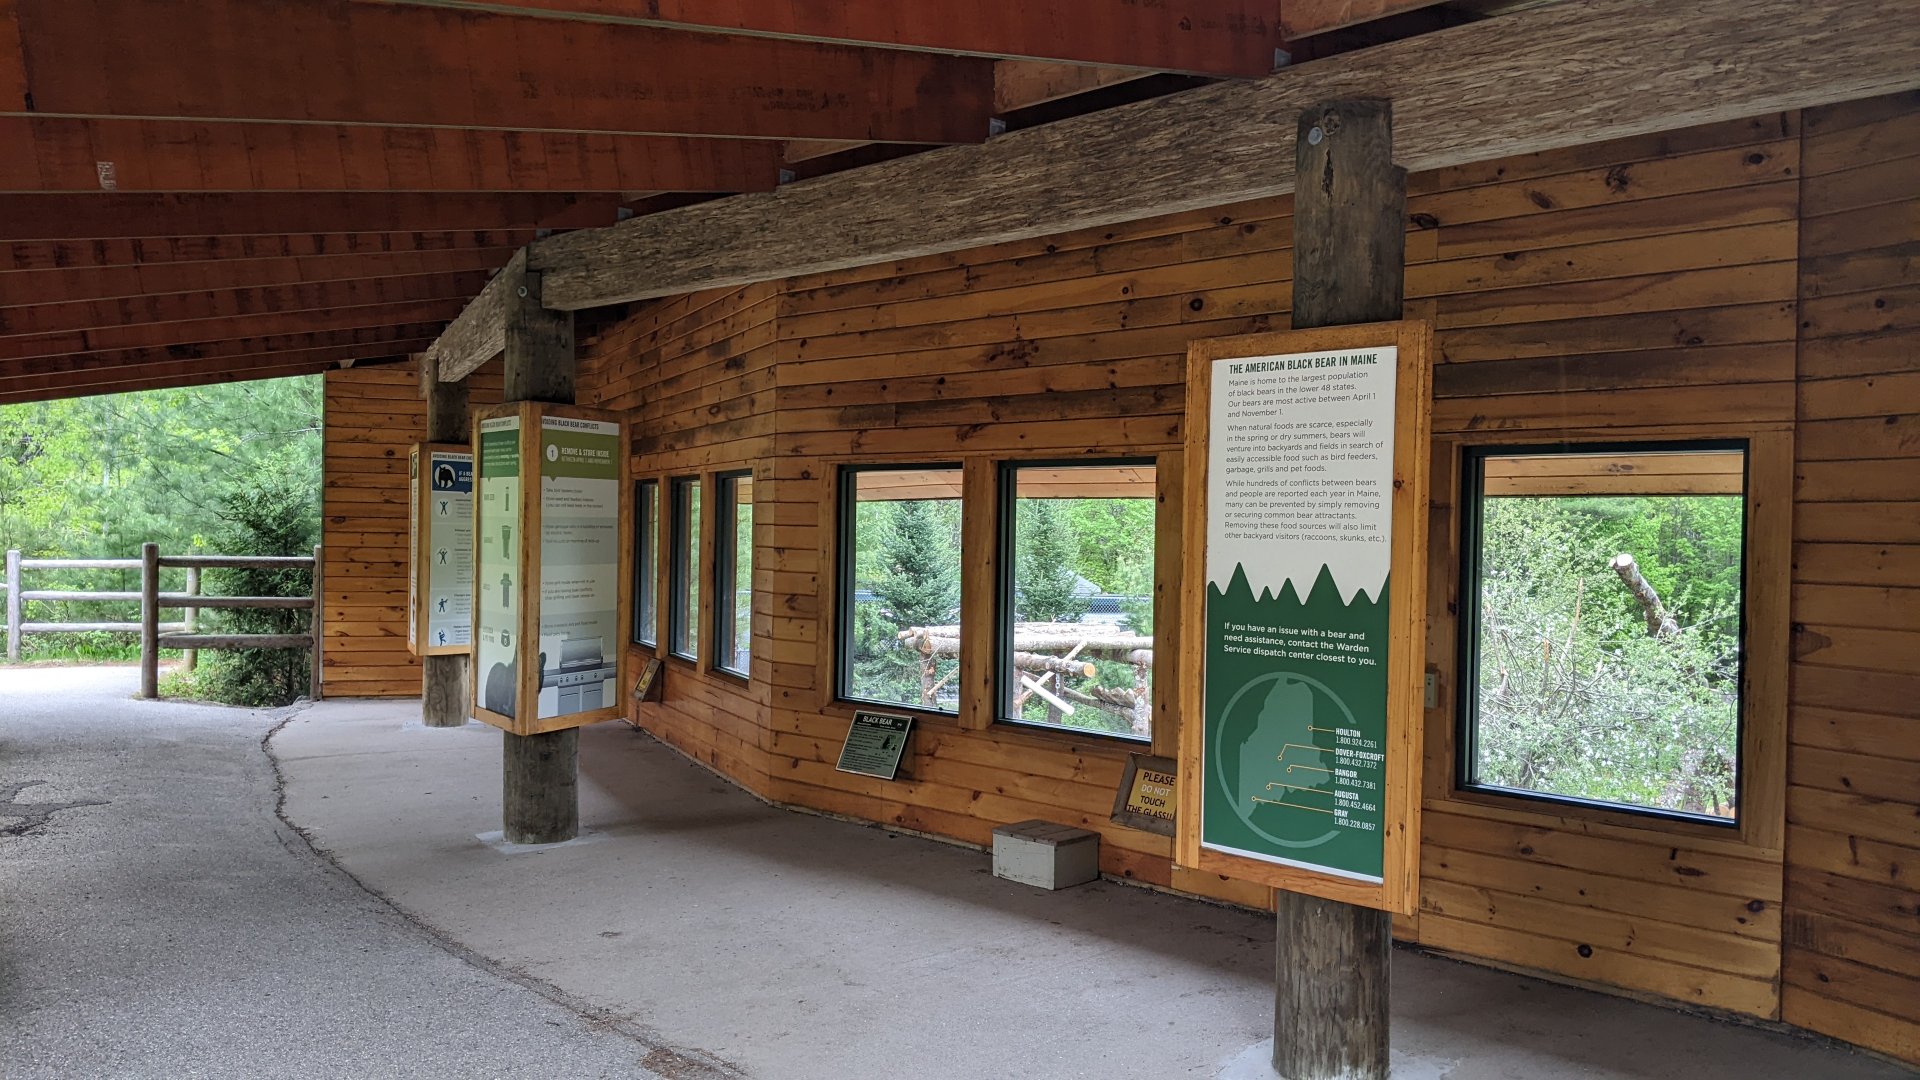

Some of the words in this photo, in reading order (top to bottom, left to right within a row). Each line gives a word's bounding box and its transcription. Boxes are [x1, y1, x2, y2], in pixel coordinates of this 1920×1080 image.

[1229, 364, 1242, 374] THE
[1244, 360, 1284, 372] AMERICAN
[1287, 358, 1312, 369] BLACK
[1315, 356, 1336, 368] BEAR
[1339, 356, 1347, 366] IN
[1350, 353, 1377, 365] MAINE
[1228, 378, 1248, 386] Maine
[1301, 373, 1325, 382] largest
[1327, 370, 1368, 381] population
[1228, 389, 1235, 397] of
[1318, 394, 1350, 402] between
[1352, 392, 1370, 401] April
[1241, 408, 1276, 416] November
[580, 422, 599, 430] CONFLICTS
[1335, 419, 1373, 428] especially
[1279, 433, 1291, 441] dry
[1267, 443, 1302, 452] backyards
[1375, 440, 1383, 448] of
[561, 447, 578, 456] REMOVE
[596, 450, 609, 458] INSIDE
[1246, 454, 1281, 462] accessible
[1347, 452, 1377, 460] feeders,
[1225, 466, 1255, 474] garbage,
[1256, 465, 1273, 473] grills
[1239, 490, 1262, 498] people
[1277, 489, 1308, 497] reported
[1269, 500, 1305, 508] prevented
[1318, 500, 1342, 509] simply
[1224, 521, 1258, 529] Removing
[1342, 522, 1358, 530] also
[1243, 532, 1273, 540] backyard
[1275, 532, 1299, 540] visitors
[1301, 533, 1337, 541] (raccoons,
[1247, 623, 1265, 632] have
[1278, 626, 1298, 634] issue
[1300, 627, 1318, 636] with
[1327, 629, 1346, 638] bear
[1348, 631, 1364, 640] and
[1224, 633, 1242, 641] need
[1244, 634, 1285, 646] assistance,
[1287, 638, 1318, 648] contact
[1320, 641, 1333, 649] the
[1336, 642, 1368, 652] Warden
[1224, 644, 1251, 653] Service
[1253, 646, 1286, 657] dispatch
[1288, 650, 1313, 659] center
[1316, 652, 1345, 662] closest
[1347, 655, 1356, 663] to
[1358, 658, 1376, 666] you.
[1336, 728, 1360, 737] HOULTON
[1336, 736, 1376, 748] 1.800.924.2261
[1335, 748, 1384, 761] DOVER-FOXCROFT
[1336, 757, 1377, 769] 1.800.432.7372
[1335, 768, 1357, 778] BANGOR
[1143, 772, 1176, 786] PLEASE
[1335, 777, 1376, 790] 1.800.432.7381
[1141, 784, 1152, 793] DO
[1154, 787, 1172, 796] NOT
[1334, 790, 1358, 800] AUGUSTA
[1141, 796, 1166, 808] TOUCH
[1334, 799, 1376, 811] 1.800.452.4664
[1127, 805, 1142, 814] THE
[1334, 809, 1348, 817] GRAY
[1334, 818, 1375, 831] 1.800.228.0857
